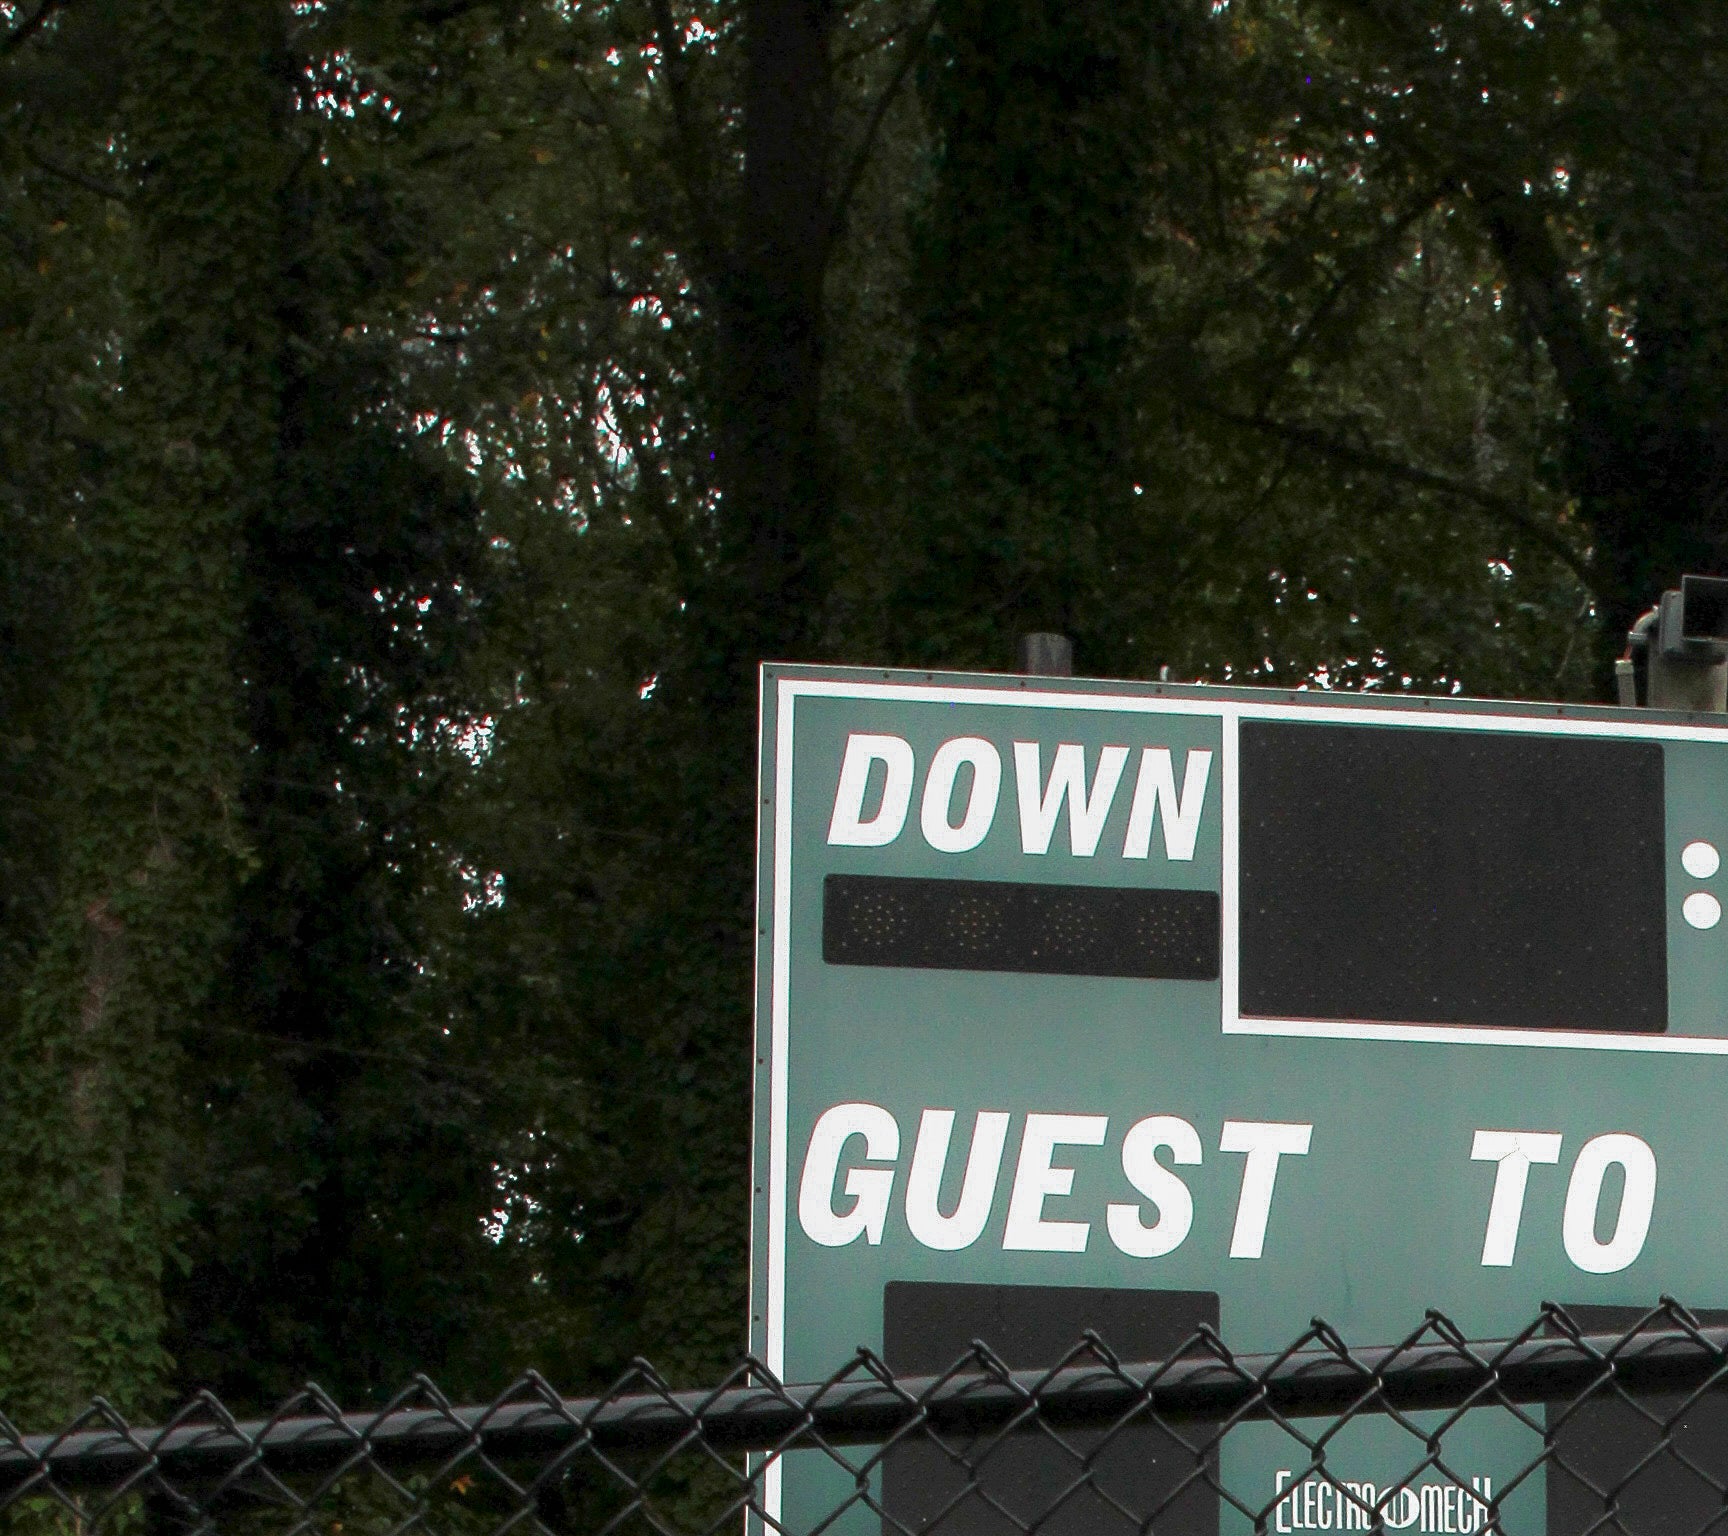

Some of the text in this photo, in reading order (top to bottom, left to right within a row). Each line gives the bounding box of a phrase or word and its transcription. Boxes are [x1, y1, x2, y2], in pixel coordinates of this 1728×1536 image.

[827, 733, 1213, 861] DOWN
[798, 1102, 1314, 1259] GUEST
[1470, 1130, 1657, 1274] TO
